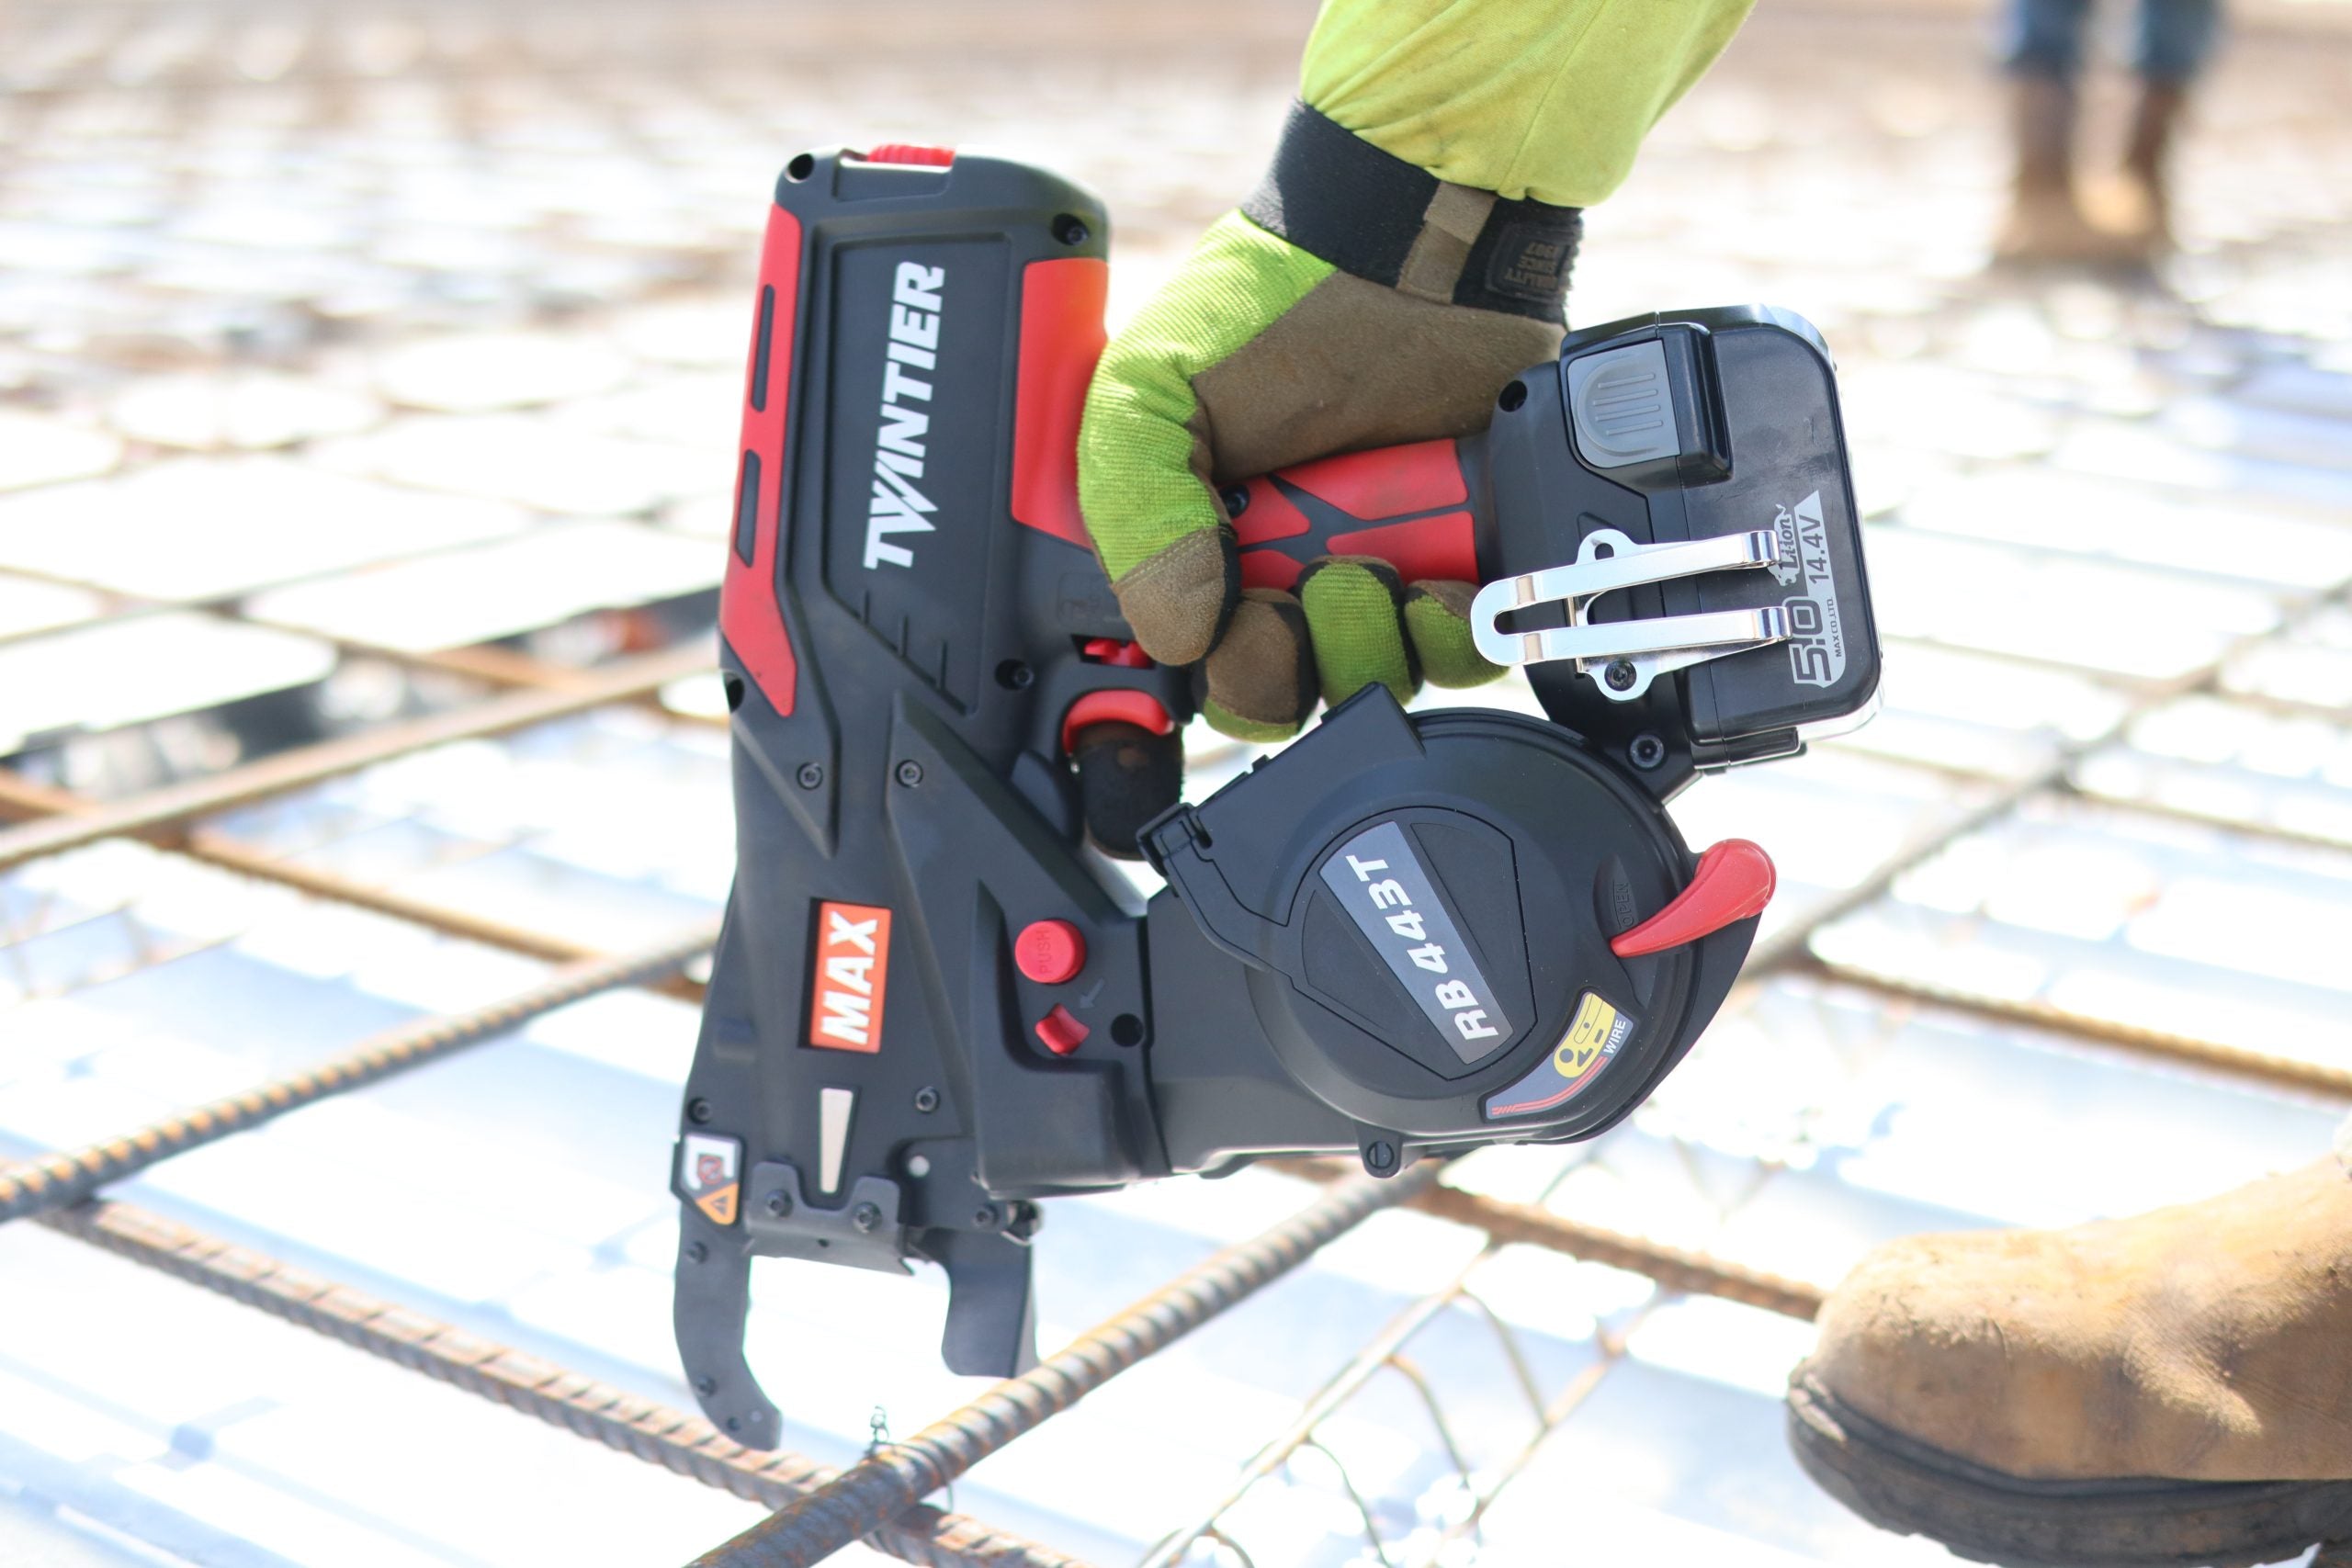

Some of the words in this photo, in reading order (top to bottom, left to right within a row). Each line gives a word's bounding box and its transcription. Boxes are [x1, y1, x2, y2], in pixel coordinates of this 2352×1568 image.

[864, 261, 945, 570] TWINTIER
[1779, 517, 1799, 570] Li-ion
[1799, 513, 1829, 585] 14.4V
[1790, 598, 1832, 682] 5.0
[1832, 635, 1842, 658] MAX
[1617, 882, 1634, 928] OPEN
[820, 910, 878, 1045] MAX
[1036, 930, 1053, 975] PUSH
[1345, 854, 1499, 1040] RB443T
[1603, 1019, 1626, 1055] WIRE
